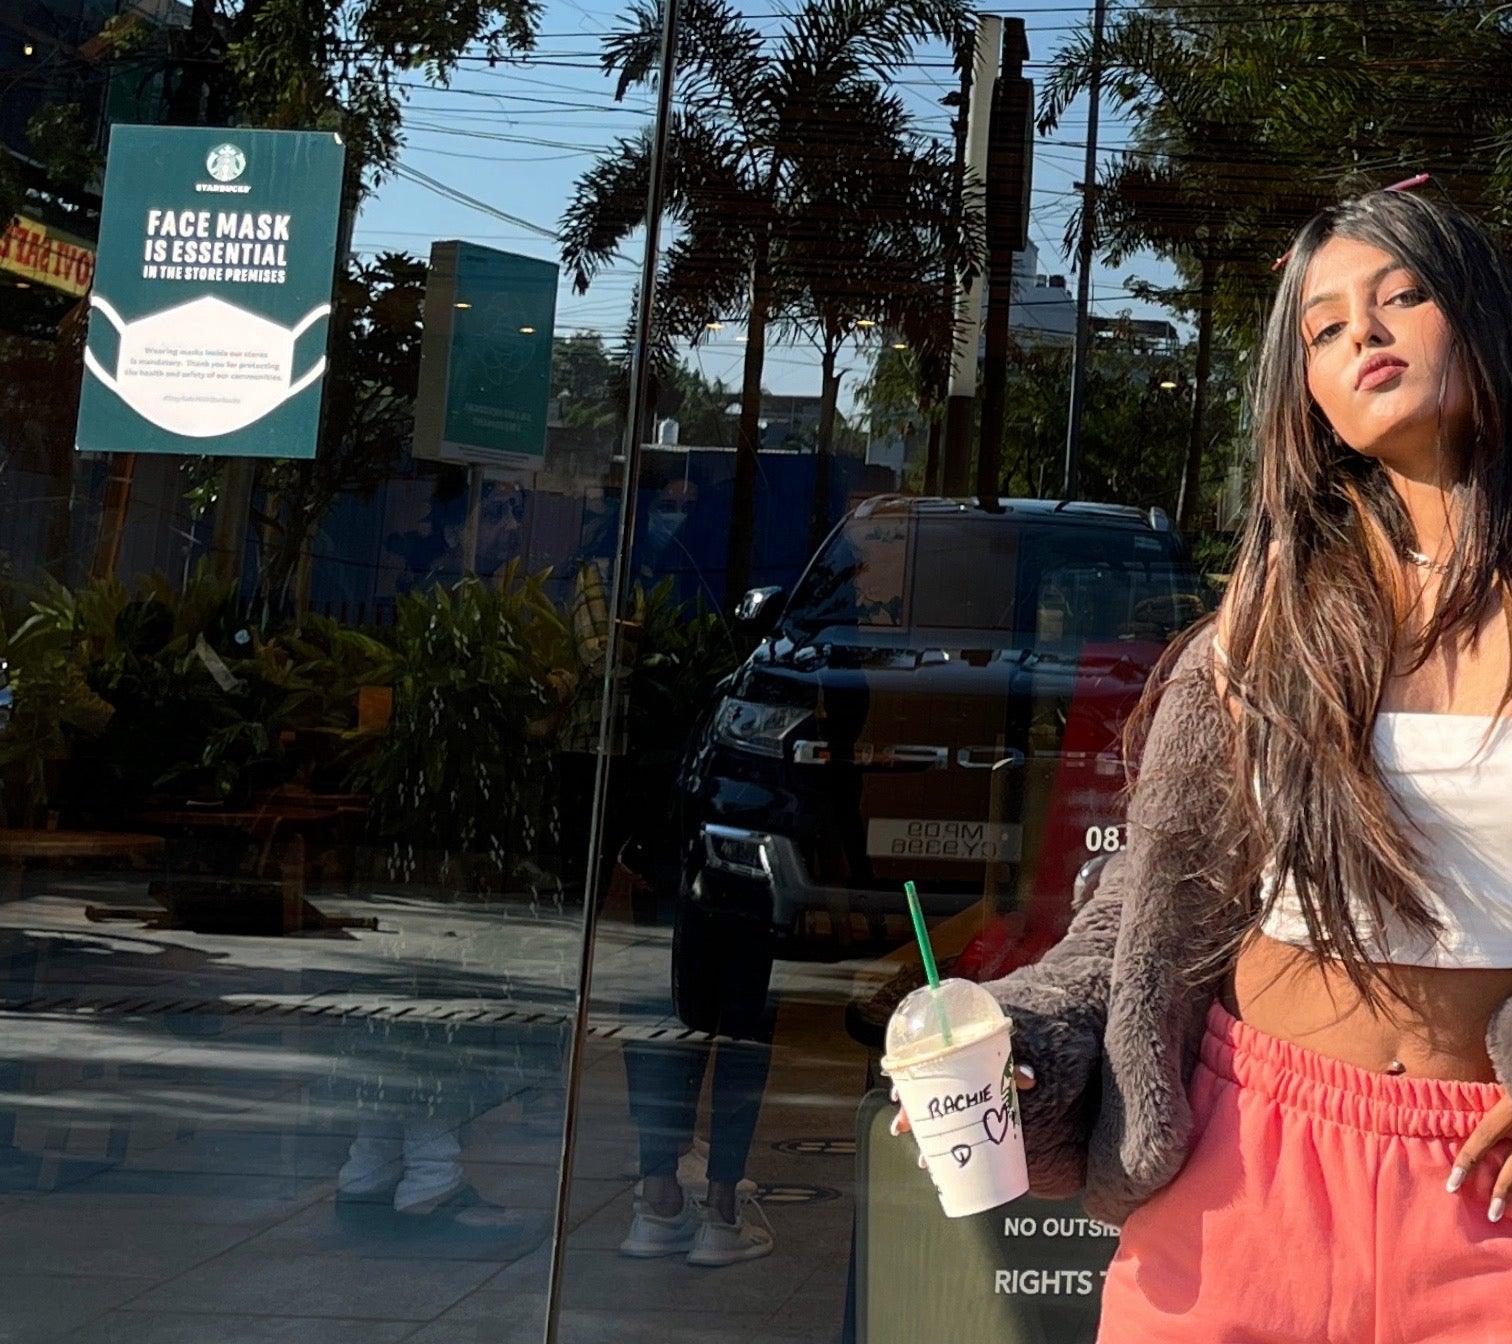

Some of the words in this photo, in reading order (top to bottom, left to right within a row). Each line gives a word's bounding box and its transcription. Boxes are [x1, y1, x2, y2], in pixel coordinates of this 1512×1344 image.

[196, 183, 250, 194] STARBUCKS
[147, 210, 211, 238] FACE
[216, 212, 291, 241] MASK
[144, 239, 168, 262] IS
[172, 240, 287, 267] ESSENTIAL
[143, 265, 158, 279] IN
[160, 265, 183, 280] THE
[184, 266, 223, 282] STORE
[224, 267, 286, 284] PREMISES
[928, 1083, 994, 1120] RACHIE
[1003, 1217, 1037, 1237] NO
[994, 1269, 1093, 1296] RIGHTS
